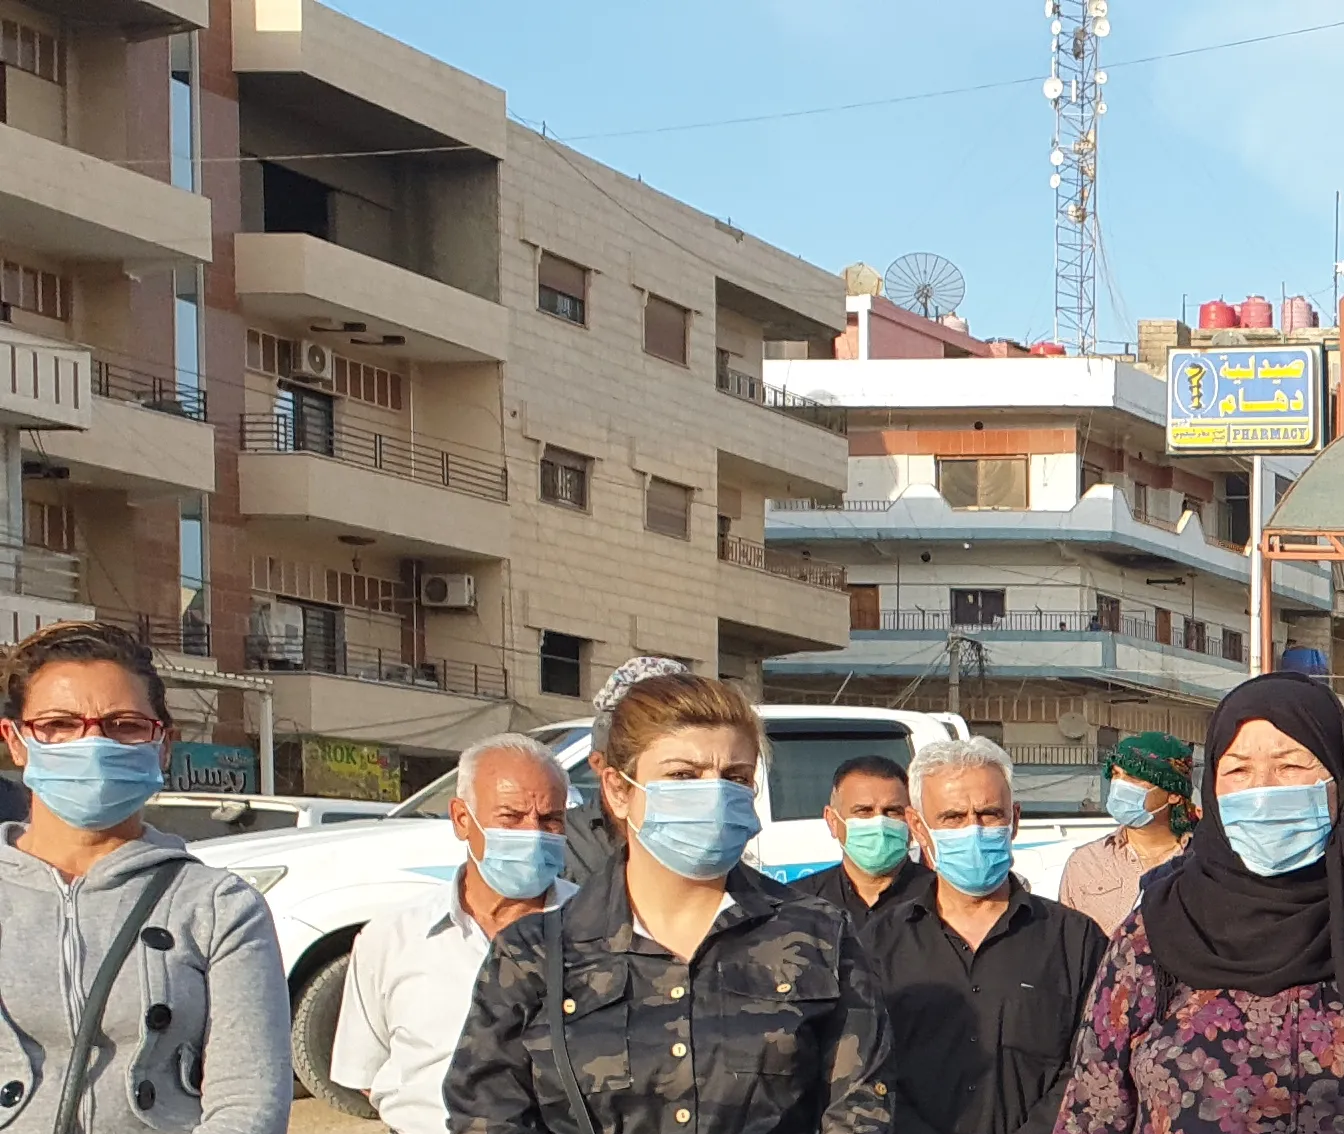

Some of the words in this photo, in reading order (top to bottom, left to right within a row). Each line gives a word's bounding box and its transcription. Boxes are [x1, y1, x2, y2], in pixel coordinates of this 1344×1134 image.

[1219, 354, 1306, 385] صيدلية
[1218, 387, 1304, 417] دهام
[1232, 427, 1307, 441] PHARMACY
